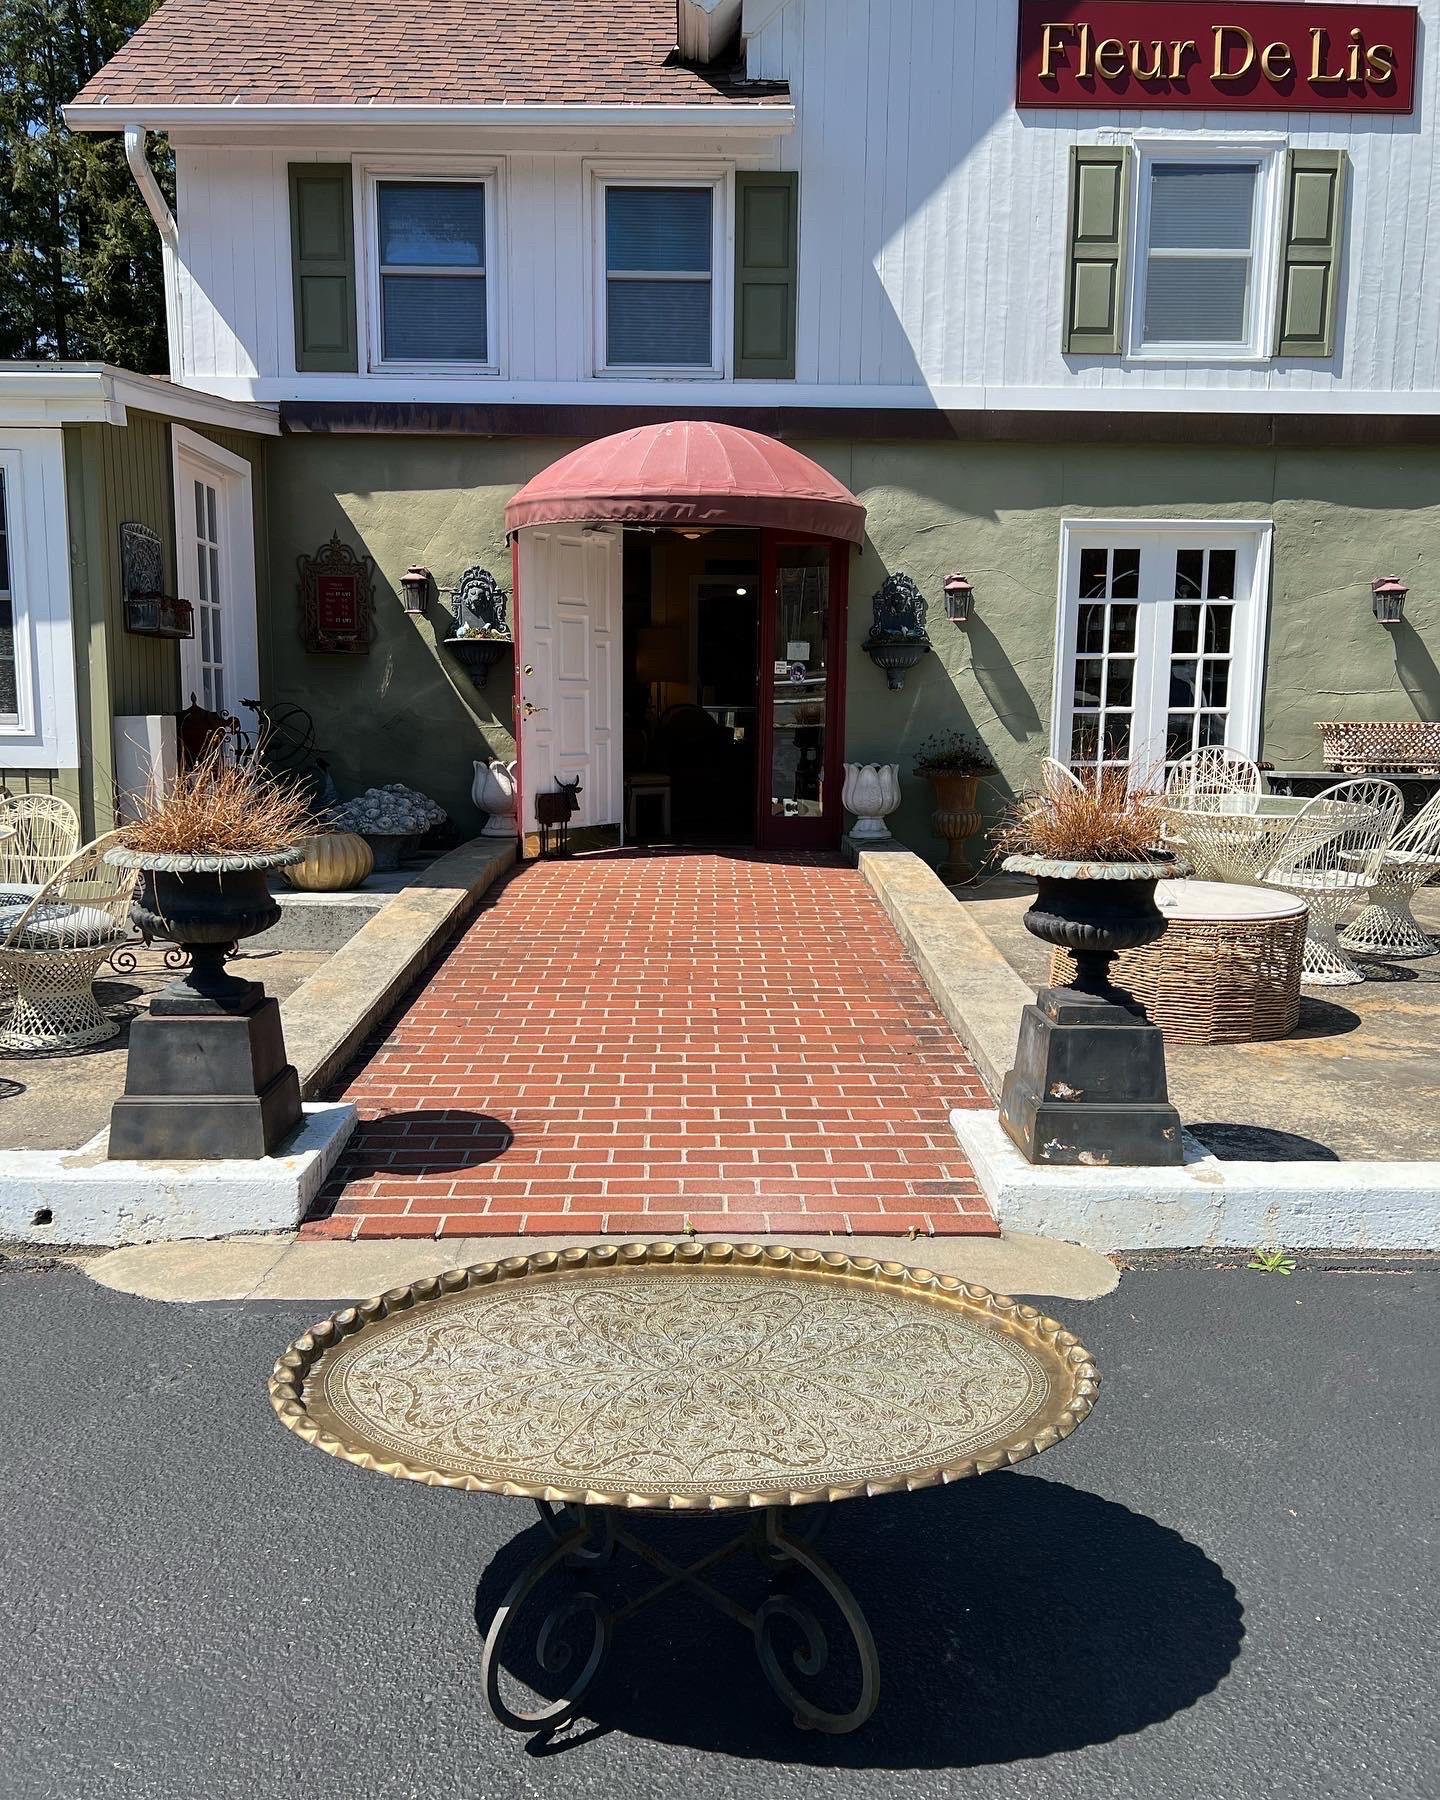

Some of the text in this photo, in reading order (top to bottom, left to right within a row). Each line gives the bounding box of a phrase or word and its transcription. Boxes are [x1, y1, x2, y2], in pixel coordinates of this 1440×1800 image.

[1038, 23, 1393, 84] Fleur De Lis
